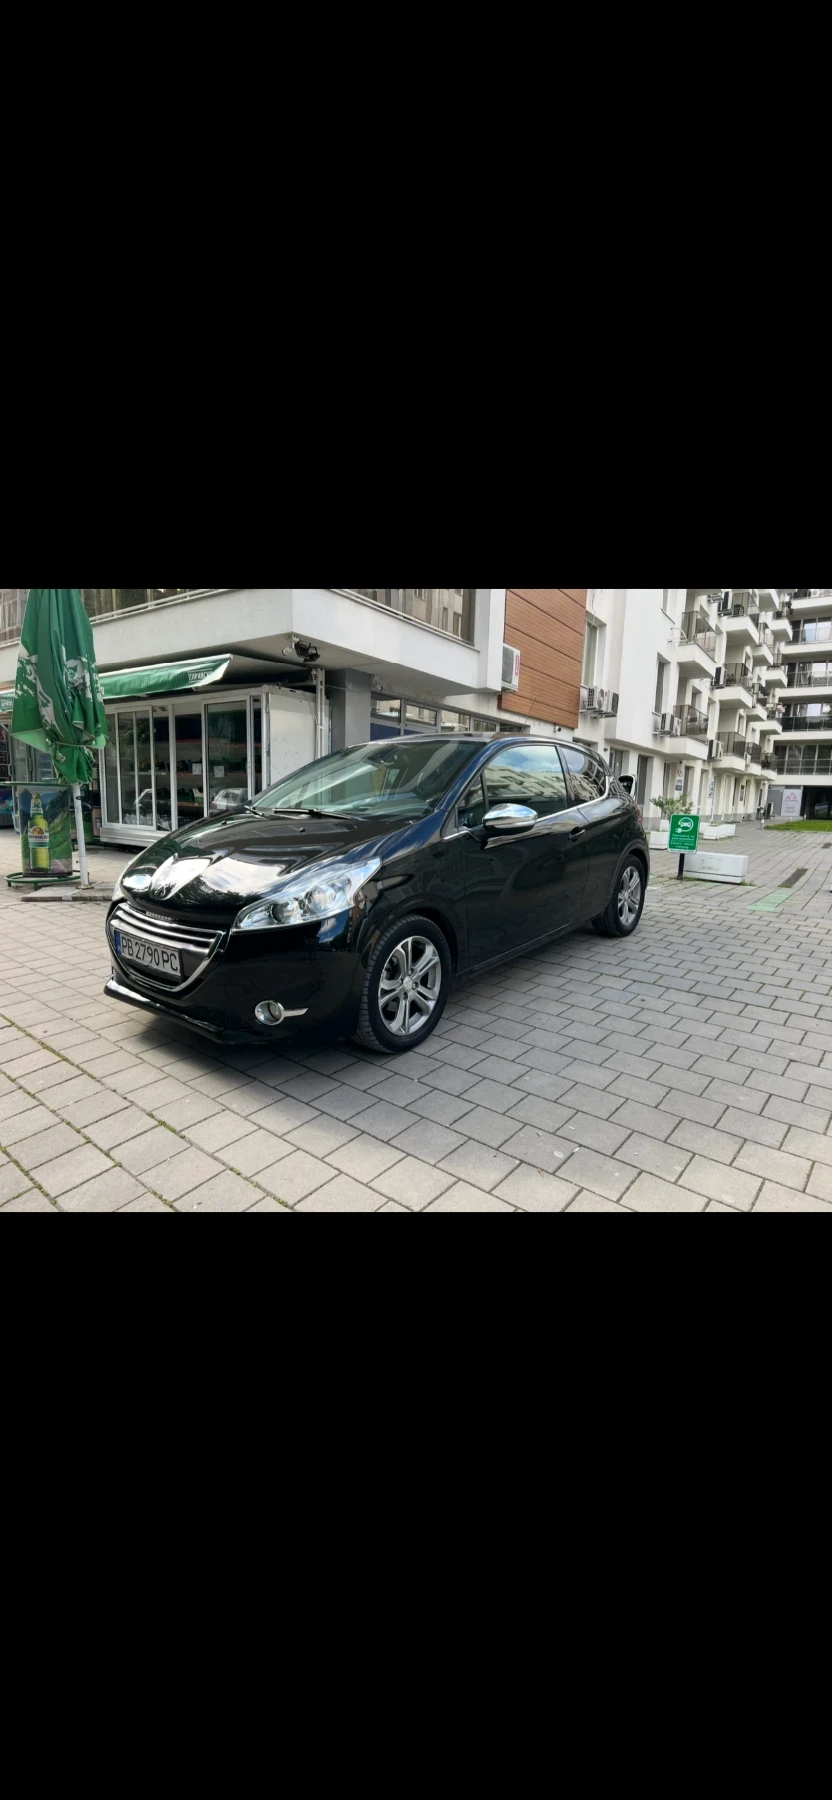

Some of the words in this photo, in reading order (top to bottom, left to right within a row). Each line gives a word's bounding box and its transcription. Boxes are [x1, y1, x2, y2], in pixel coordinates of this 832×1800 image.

[121, 936, 134, 956] PB
[134, 942, 160, 966] 2790
[161, 950, 178, 972] PC
